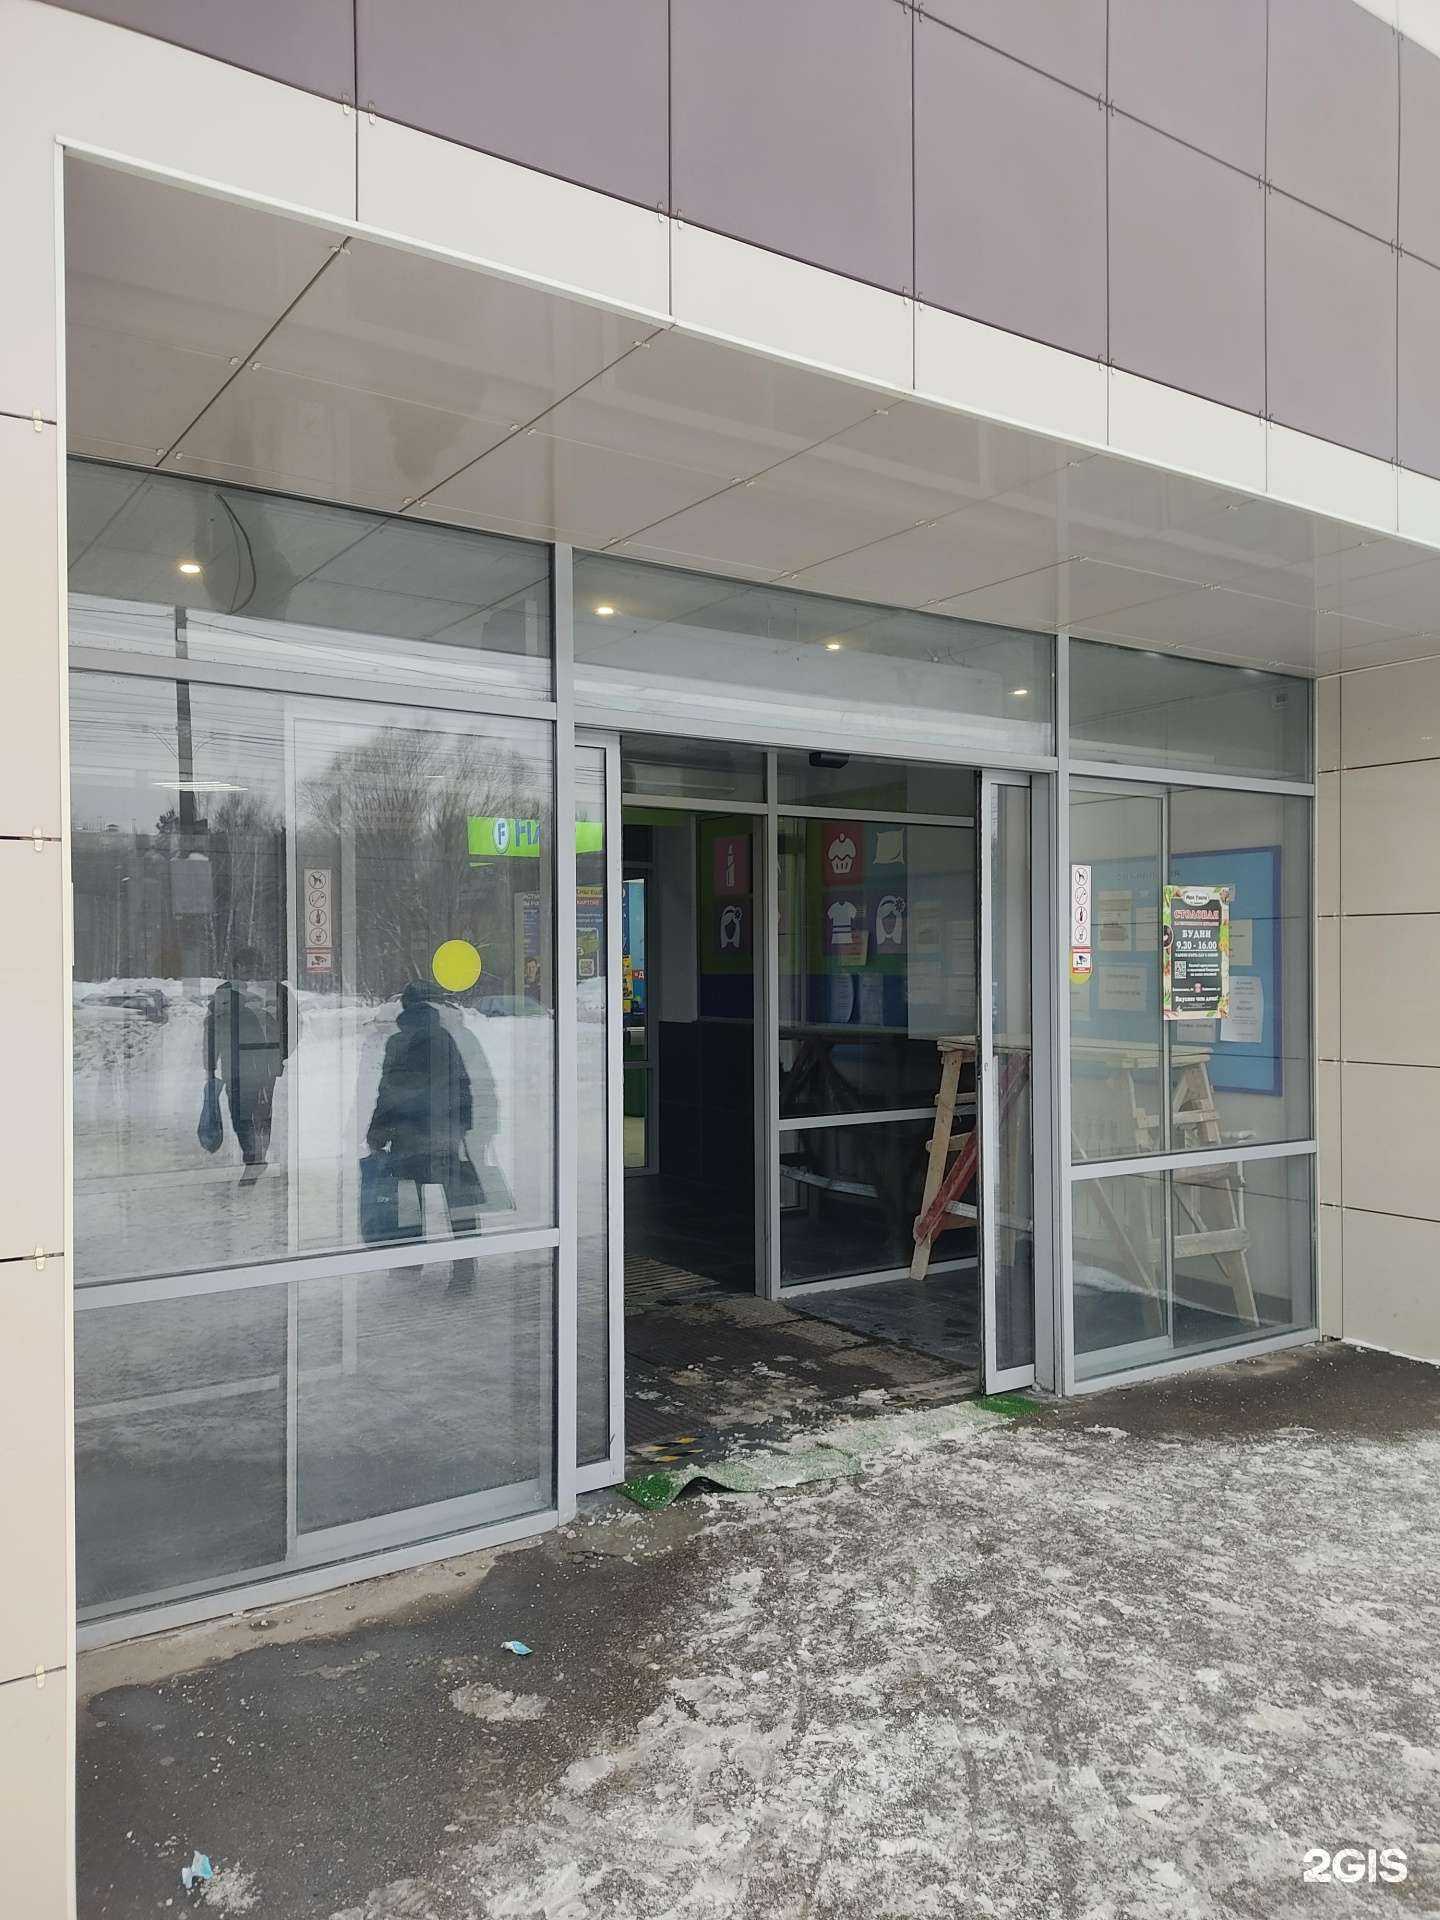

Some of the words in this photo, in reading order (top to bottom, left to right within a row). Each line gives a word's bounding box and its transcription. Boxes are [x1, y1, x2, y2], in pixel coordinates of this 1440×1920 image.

[1174, 910, 1219, 919] СТОЛОВАЯ
[1182, 930, 1211, 938] БУДНИ
[1176, 940, 1192, 949] 9.30
[1198, 940, 1217, 949] 16.00
